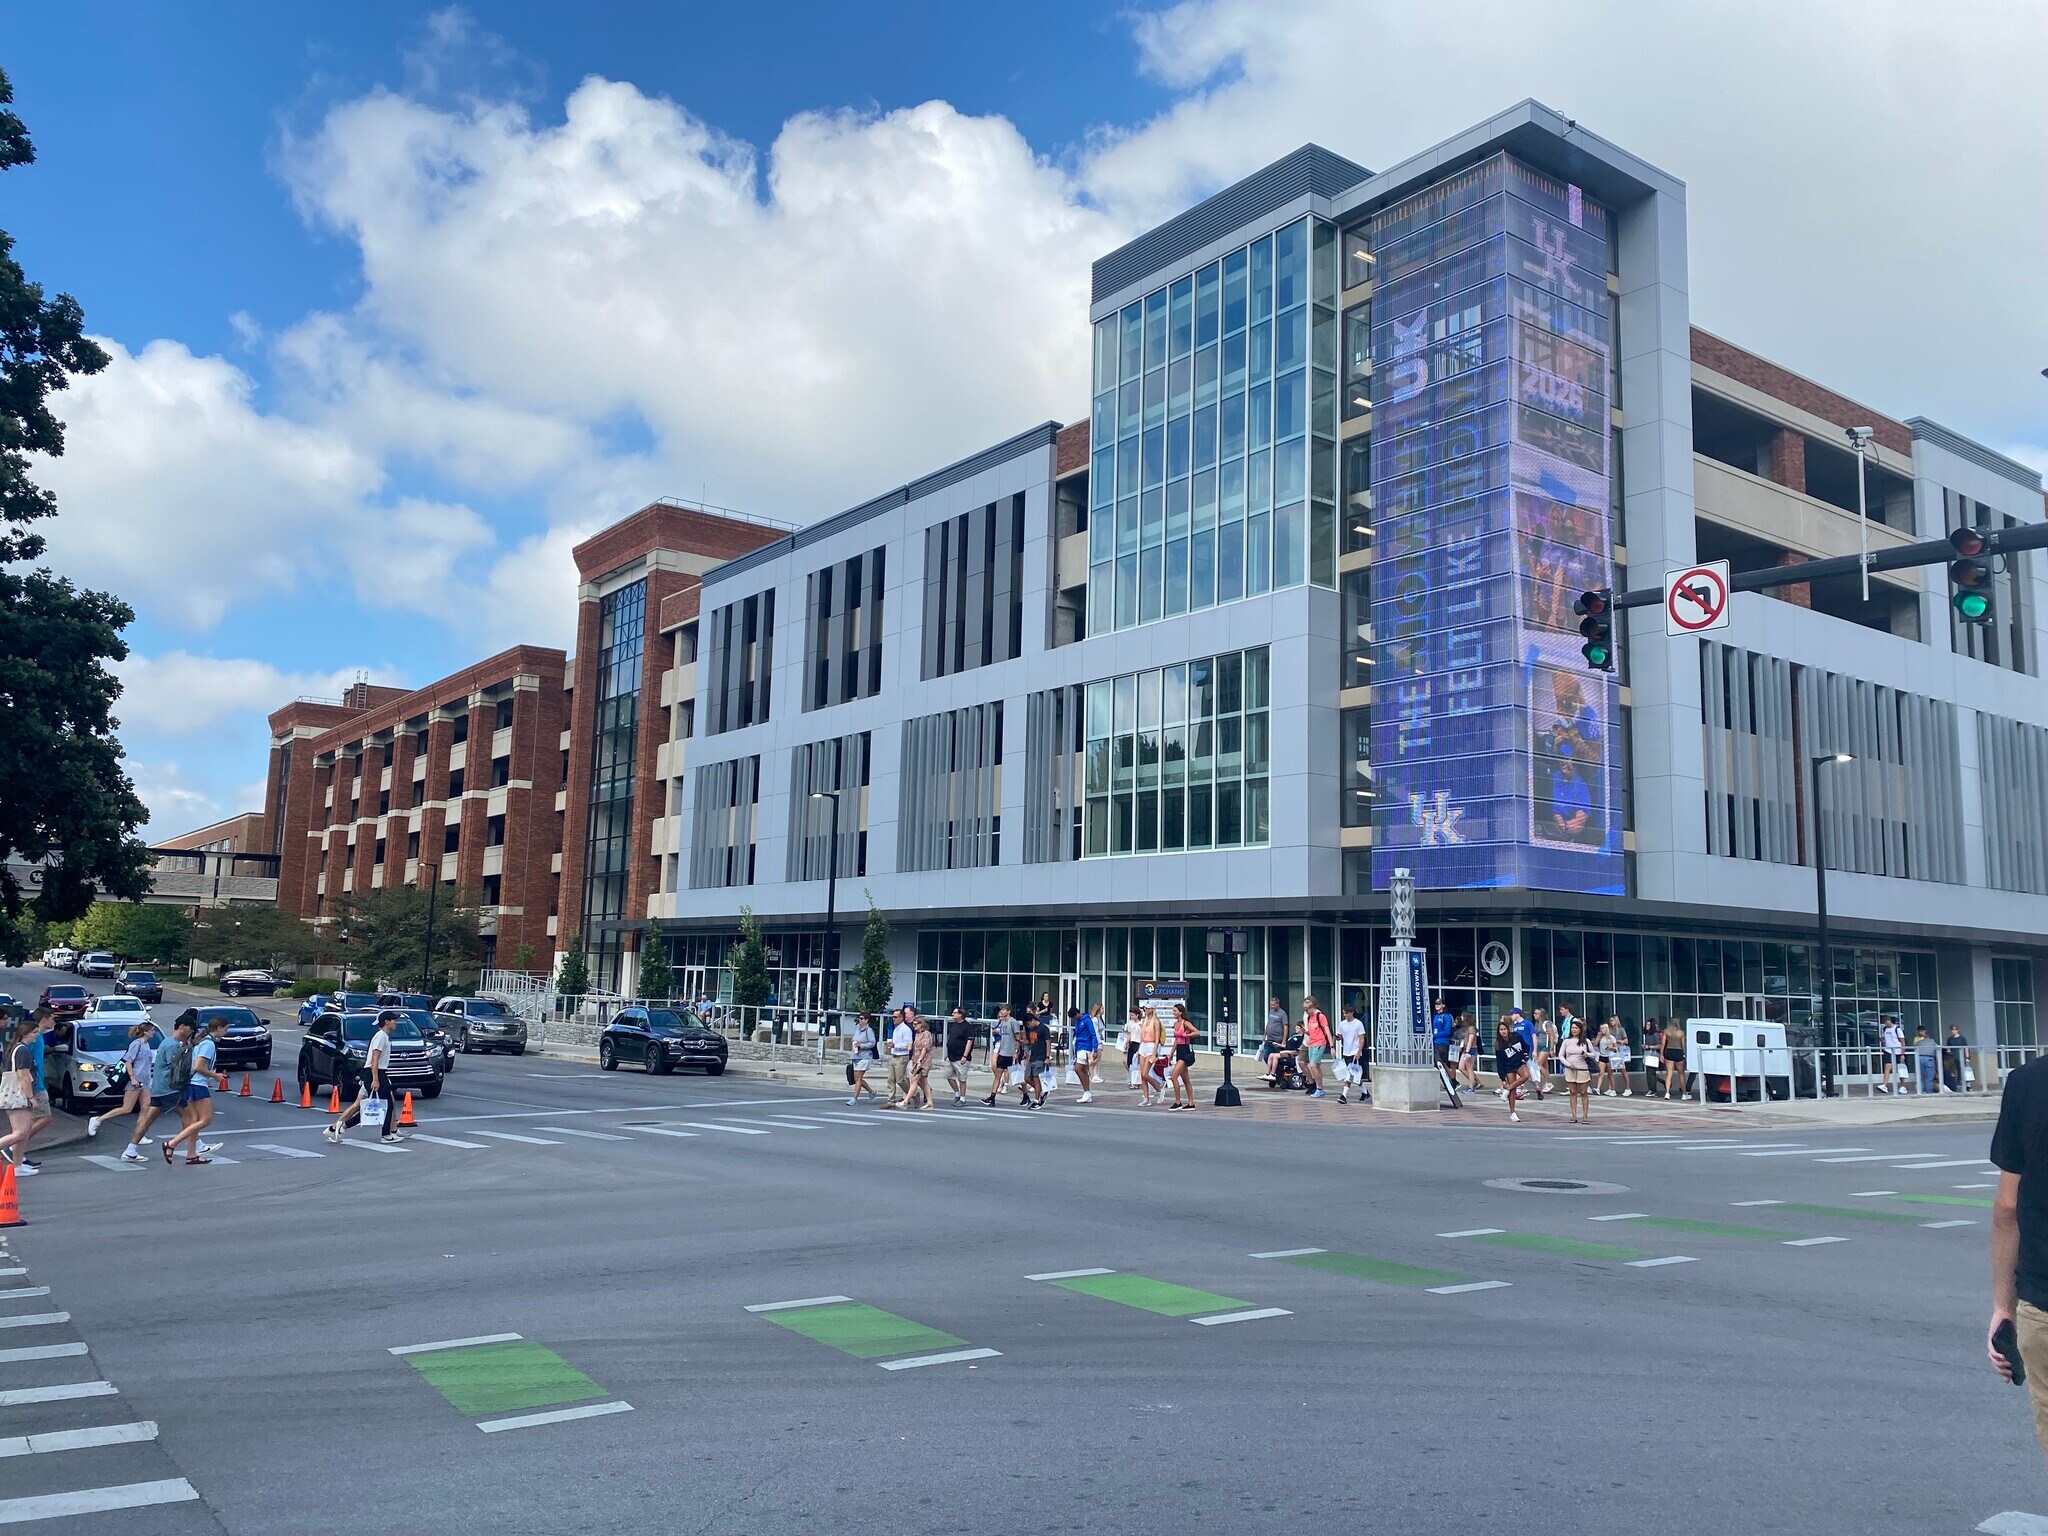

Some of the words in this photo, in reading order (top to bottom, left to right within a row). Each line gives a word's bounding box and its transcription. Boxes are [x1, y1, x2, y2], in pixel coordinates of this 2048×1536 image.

[1531, 214, 1582, 294] UK
[1393, 307, 1429, 404] UK
[1395, 416, 1430, 671] MOMENT
[1447, 525, 1481, 613] LIKE
[1448, 630, 1482, 716] FELT
[1398, 679, 1432, 755] THE
[1409, 789, 1465, 848] UK
[1154, 988, 1188, 996] EXCHANGE
